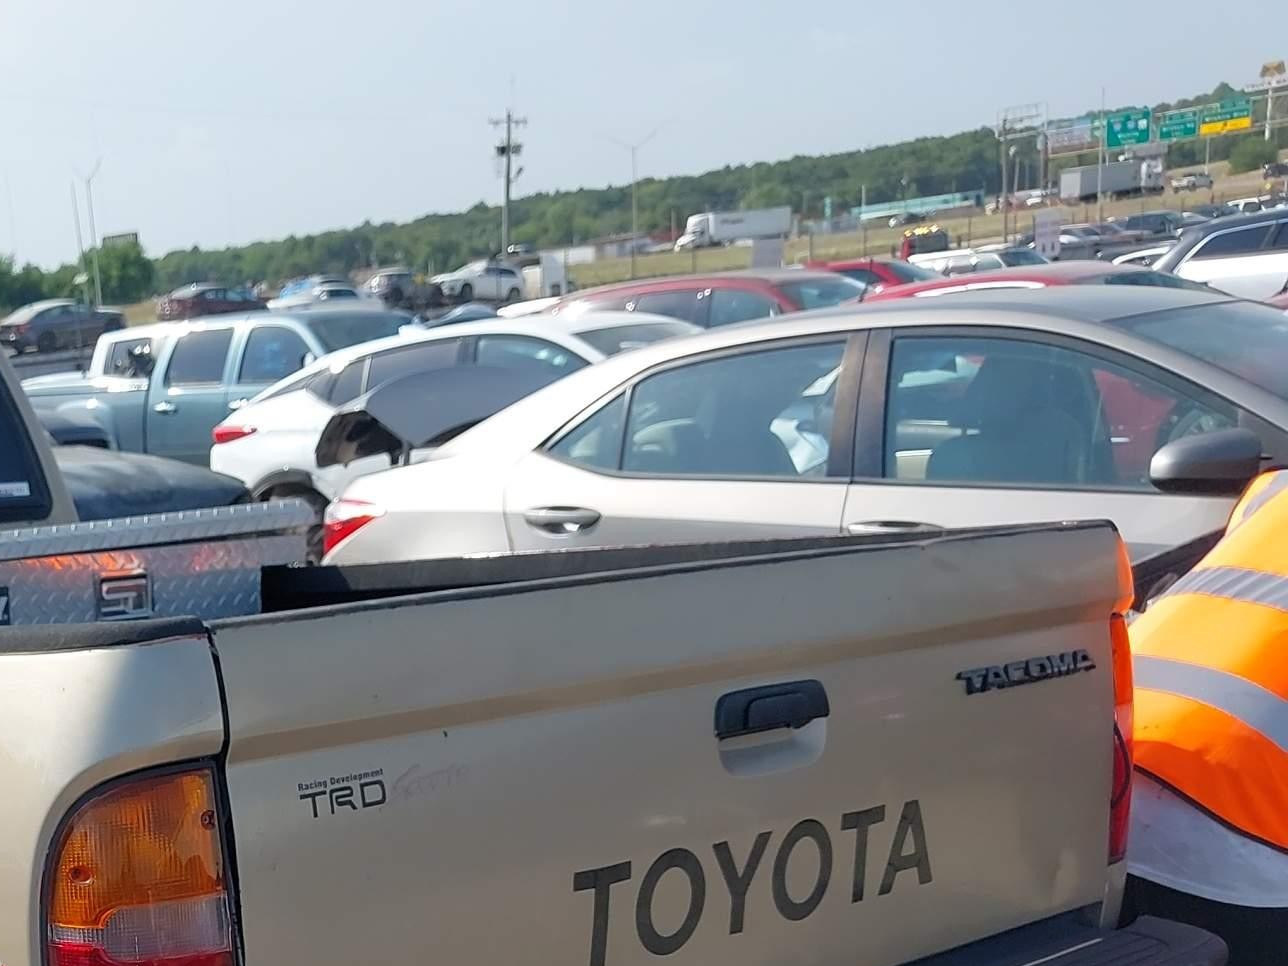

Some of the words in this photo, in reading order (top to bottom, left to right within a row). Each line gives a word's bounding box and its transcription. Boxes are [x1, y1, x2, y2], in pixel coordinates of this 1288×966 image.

[956, 649, 1097, 695] TACOMA
[298, 778, 328, 792] Racing
[330, 768, 384, 785] Development
[299, 779, 387, 818] TRD
